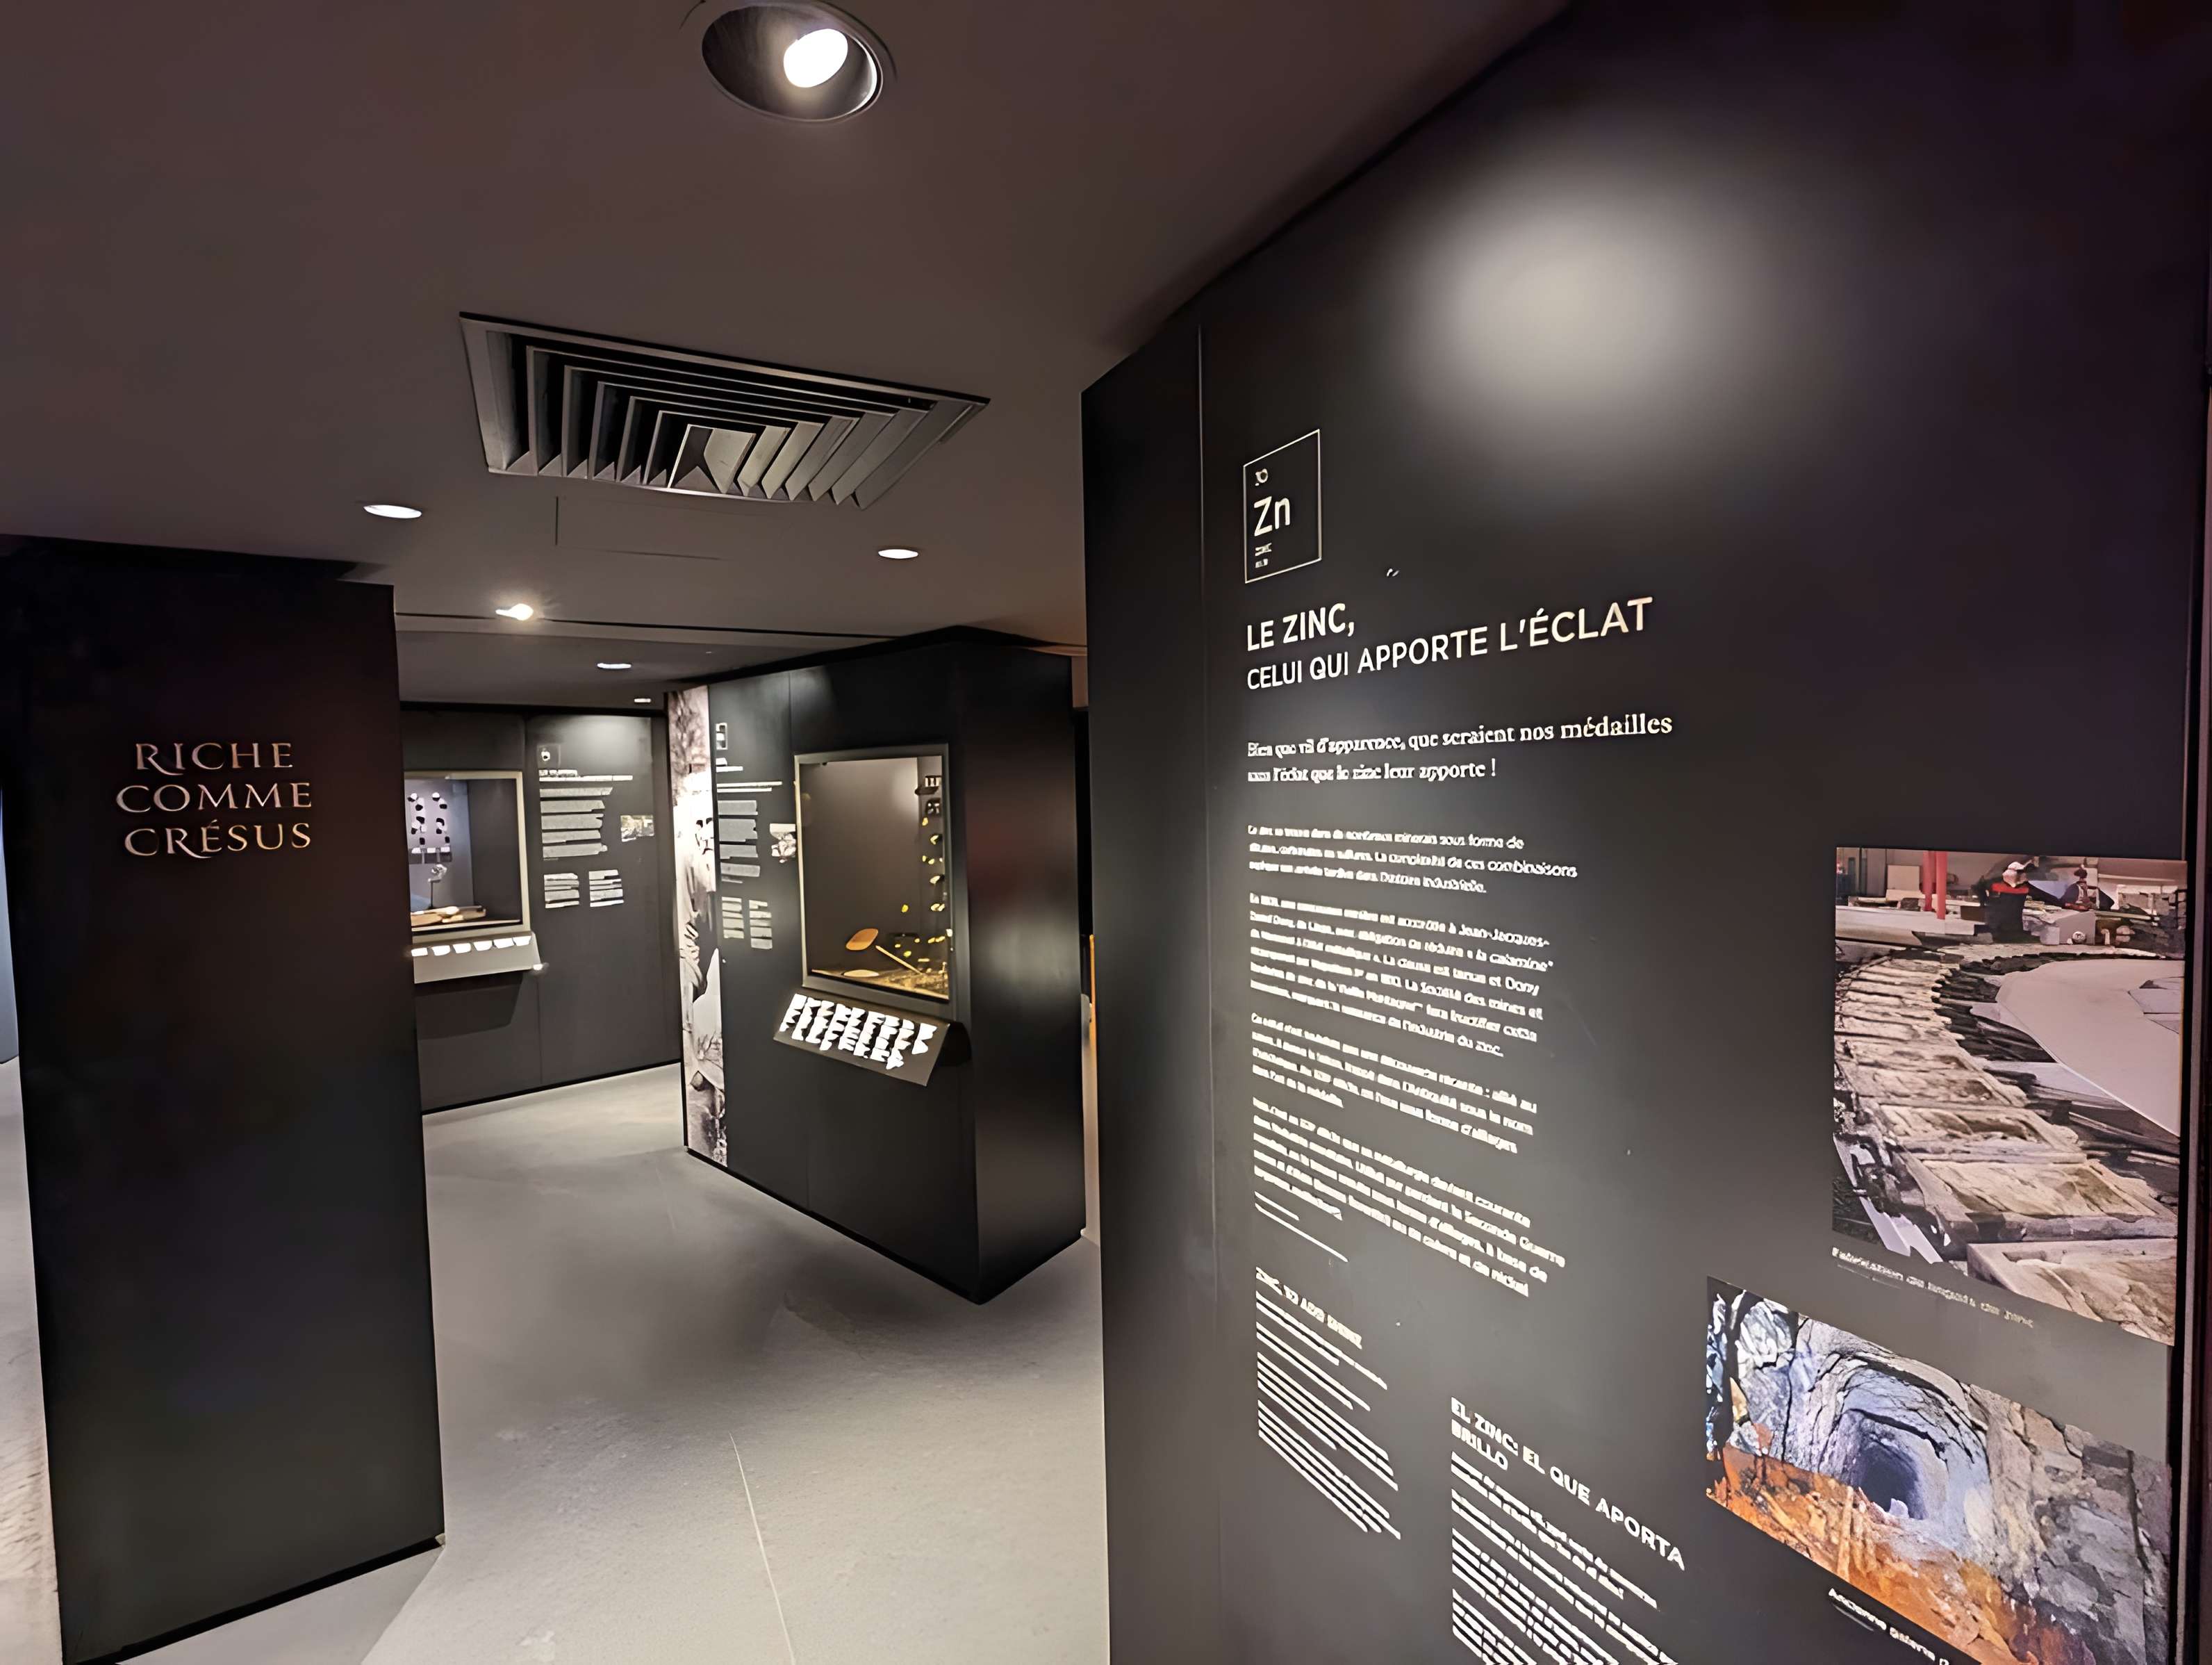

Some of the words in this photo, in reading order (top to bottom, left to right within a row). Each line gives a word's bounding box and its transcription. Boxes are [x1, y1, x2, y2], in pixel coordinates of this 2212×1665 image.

[1254, 496, 1290, 536] Zn
[1248, 621, 1274, 651] LE
[1282, 603, 1354, 643] ZINC,
[1248, 660, 1302, 689] CELUI
[1310, 652, 1348, 680] QUI
[1357, 626, 1487, 673] APPORTE
[1501, 597, 1653, 651] L'ÉCLAT
[1408, 735, 1438, 751] que
[1442, 725, 1515, 746] seraient
[1520, 726, 1554, 741] nos
[1561, 713, 1672, 739] médailles
[136, 743, 292, 776] RICHE
[1492, 758, 1495, 776] !
[116, 782, 311, 812] COMME
[125, 819, 311, 858] CRÉSUS
[1451, 1397, 1471, 1423] EL
[1523, 1445, 1545, 1474] EL
[1550, 1466, 1590, 1506] QUE
[1594, 1498, 1685, 1573] APORTA
